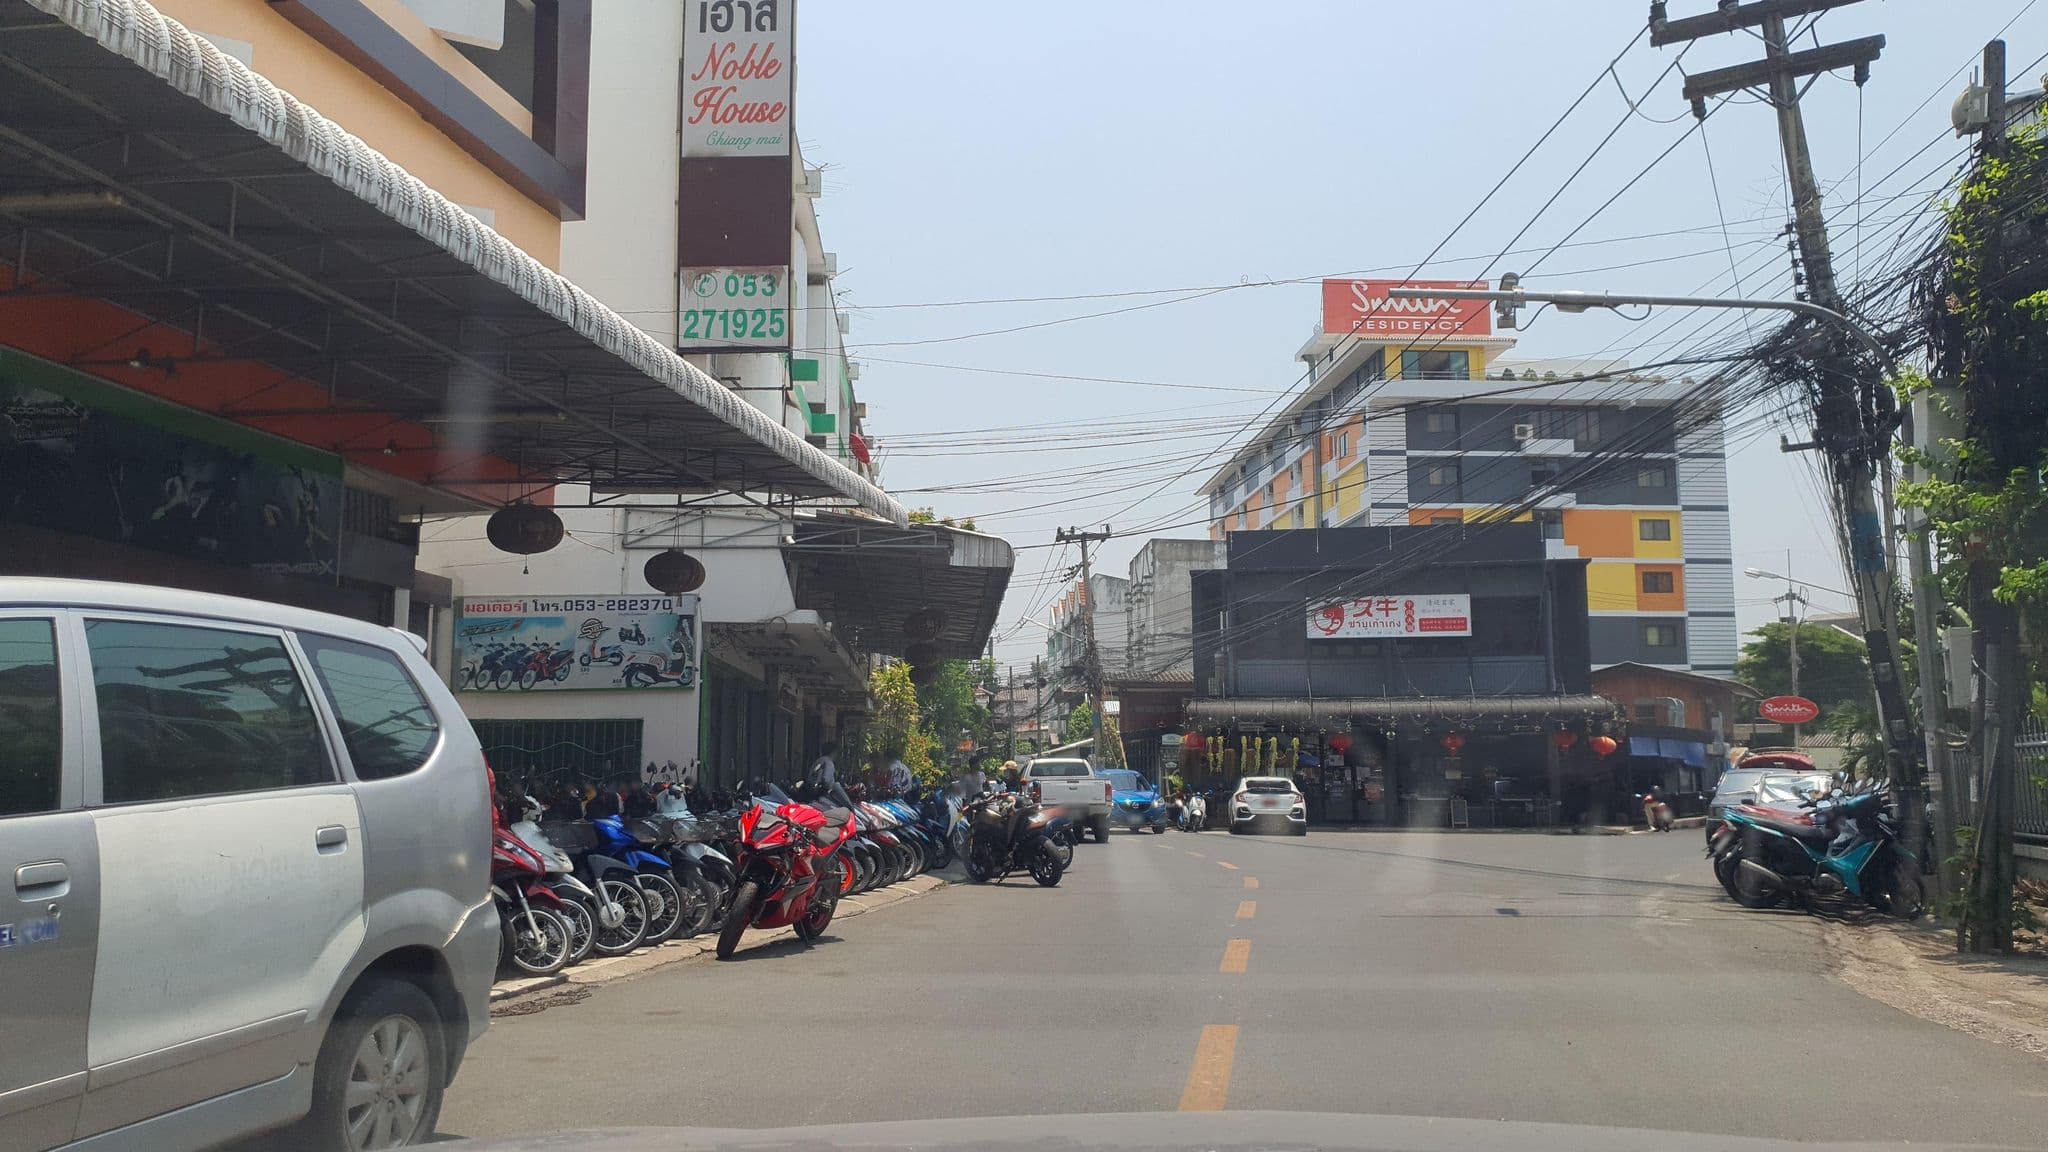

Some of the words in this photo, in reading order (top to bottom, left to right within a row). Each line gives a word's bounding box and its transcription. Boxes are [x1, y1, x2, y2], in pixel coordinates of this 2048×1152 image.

[691, 41, 783, 82] Noble
[688, 85, 788, 126] House
[706, 130, 754, 150] Chiang
[756, 132, 784, 146] mai
[724, 274, 778, 298] 053
[683, 308, 786, 340] 271925
[1352, 320, 1464, 331] RESIDENCE
